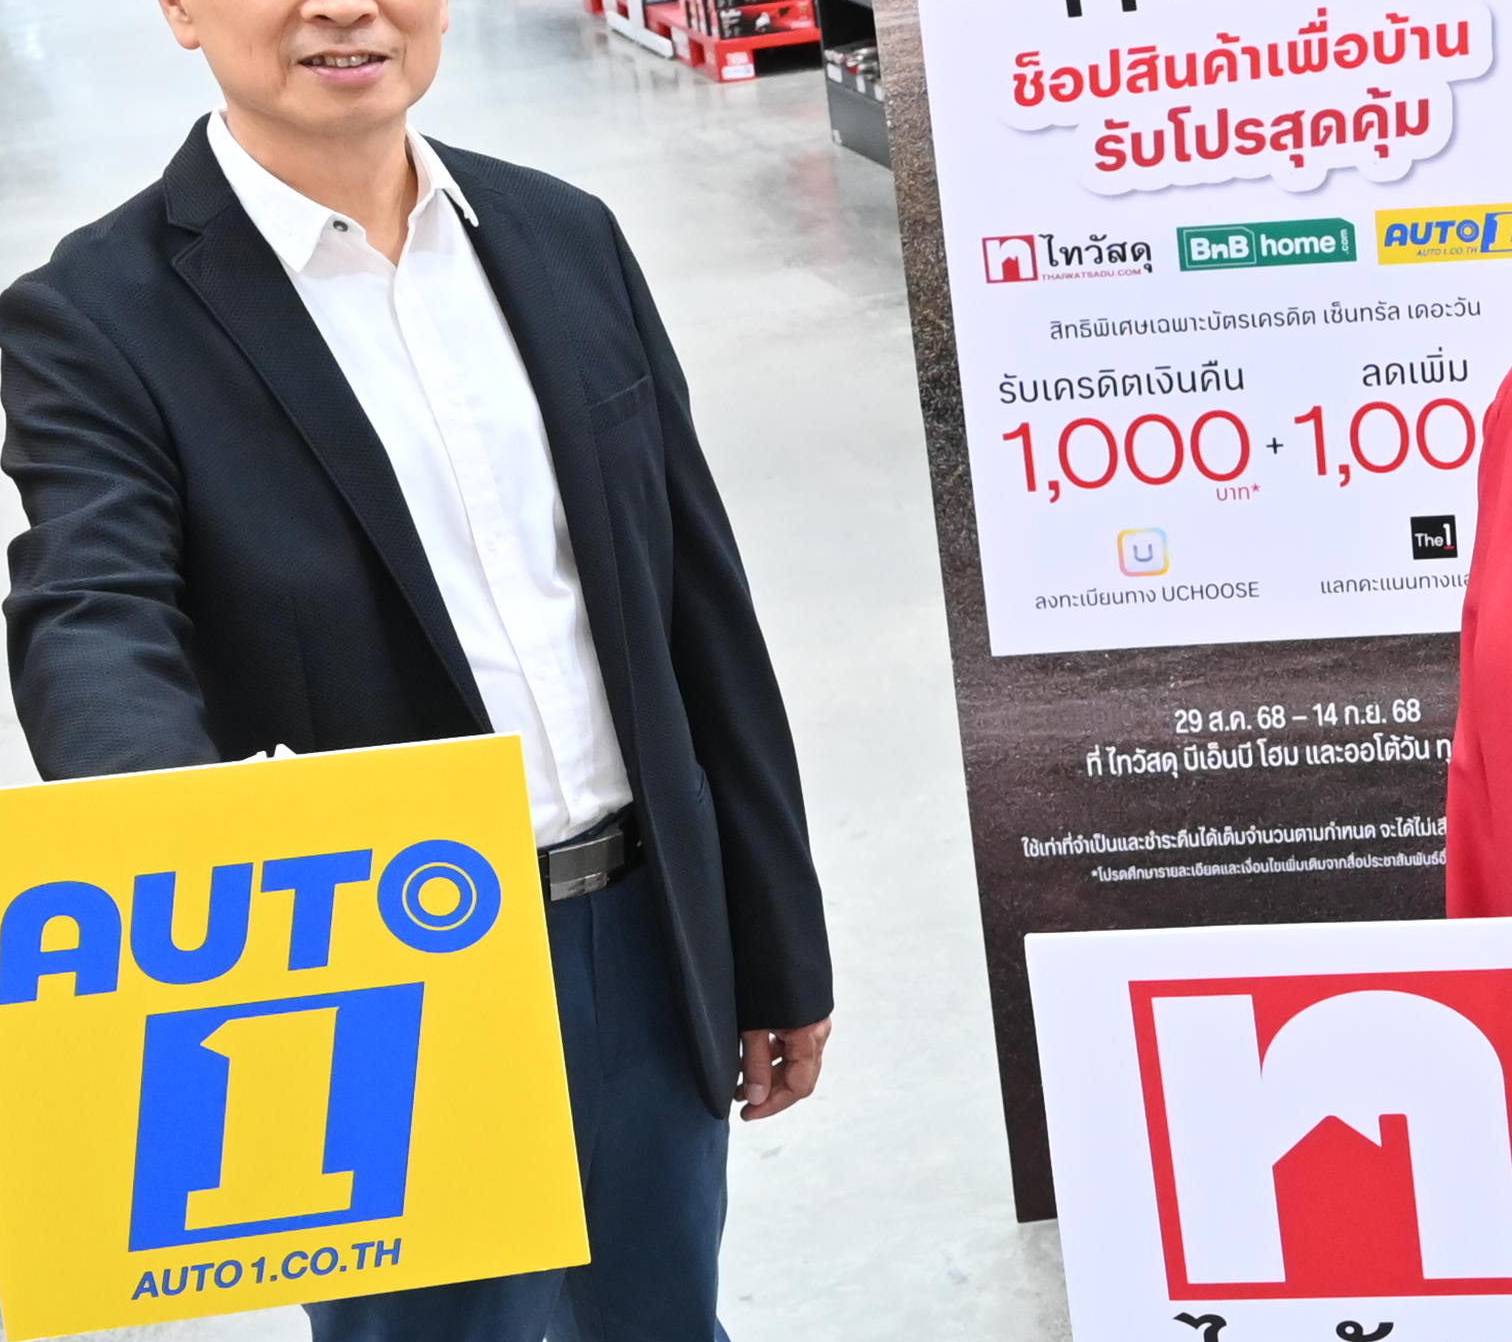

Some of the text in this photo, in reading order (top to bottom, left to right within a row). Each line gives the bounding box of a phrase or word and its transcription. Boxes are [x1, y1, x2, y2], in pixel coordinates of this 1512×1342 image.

[1011, 8, 1471, 109] ช็อปสินค้าเพื่อบ้าน
[1092, 86, 1431, 173] รับโปรสุดคุ้ม
[1039, 232, 1154, 274] ไทวัสดุ
[1189, 233, 1249, 261] BnB
[1259, 229, 1337, 258] home
[1048, 298, 1483, 343] สิทธิพิเศษเฉพาะบัตรเครดิต เซ็นทรัล เดอะวัน
[998, 358, 1246, 406] รับเครดิตเงินคืน
[1360, 347, 1470, 389] ลดเพิ่ม
[1000, 396, 1478, 504] 1,000 1,00
[1034, 581, 1261, 611] ลงทะเบียนทาง UCHOOSE
[1174, 698, 1421, 733] 29 ส.ค. 68 14 ก.ย. 68
[1086, 733, 1429, 780] ที่ ไทวัสดุ บีเอ็นบี โฮม และออโต้วัน
[130, 1237, 402, 1301] AUTO1.CO.TH
